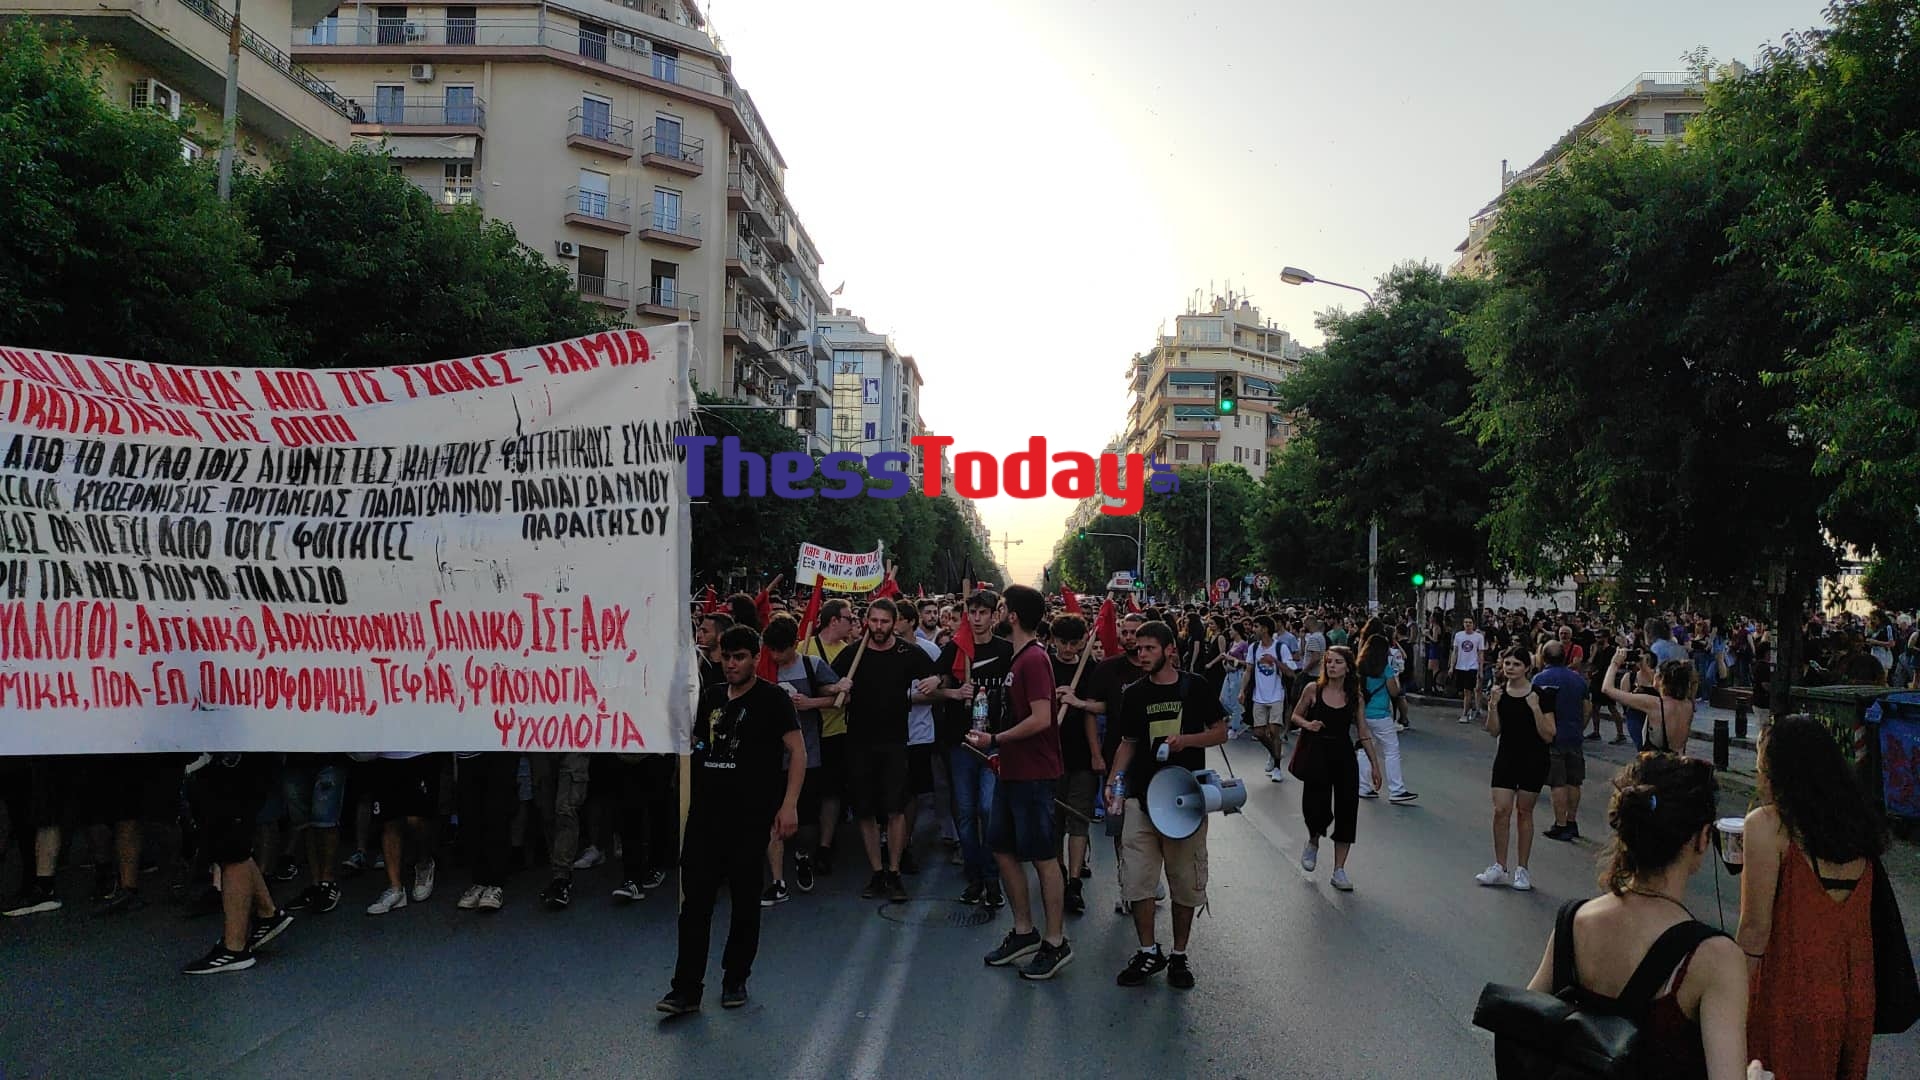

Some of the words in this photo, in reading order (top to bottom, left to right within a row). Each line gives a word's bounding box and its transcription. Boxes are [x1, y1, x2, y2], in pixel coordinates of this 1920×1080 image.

[255, 370, 328, 411] ΑΠΟ
[327, 370, 392, 406] ΤΙΣ
[392, 352, 522, 398] ΣΧΟΛΕΣ
[537, 330, 649, 374] ΚΑΜΙΑ
[196, 410, 270, 443] ΤΗΣ
[270, 414, 357, 447] ΟΠΠΙ
[3, 434, 64, 474] ΑΠΟ
[74, 439, 105, 476] ΤΟ
[195, 447, 252, 483] ΤΟΥΣ
[401, 443, 440, 481] ΚΑΙ
[444, 439, 496, 477] ΤΟΥΣ
[500, 424, 614, 473] ΦΟΙΤΗΤΙΚΟΥΣ
[48, 513, 86, 554] ΘΑ
[158, 515, 212, 560] ΑΠΟ
[224, 517, 284, 561] ΤΟΥΣ
[292, 520, 414, 561] ΦΟΙΤΗΤΕΣ
[522, 505, 670, 541] ΠΑΡΑΙΤΗΣΟΥ
[39, 560, 83, 600] ΓΙΑ
[84, 561, 138, 601] ΝΕΟ
[139, 563, 231, 602] ΝΟΜΟ
[233, 565, 348, 605] ΠΛΑΙΣΙΟ
[494, 707, 645, 750] ΨΥΧΟΛΟΓΙΑ
